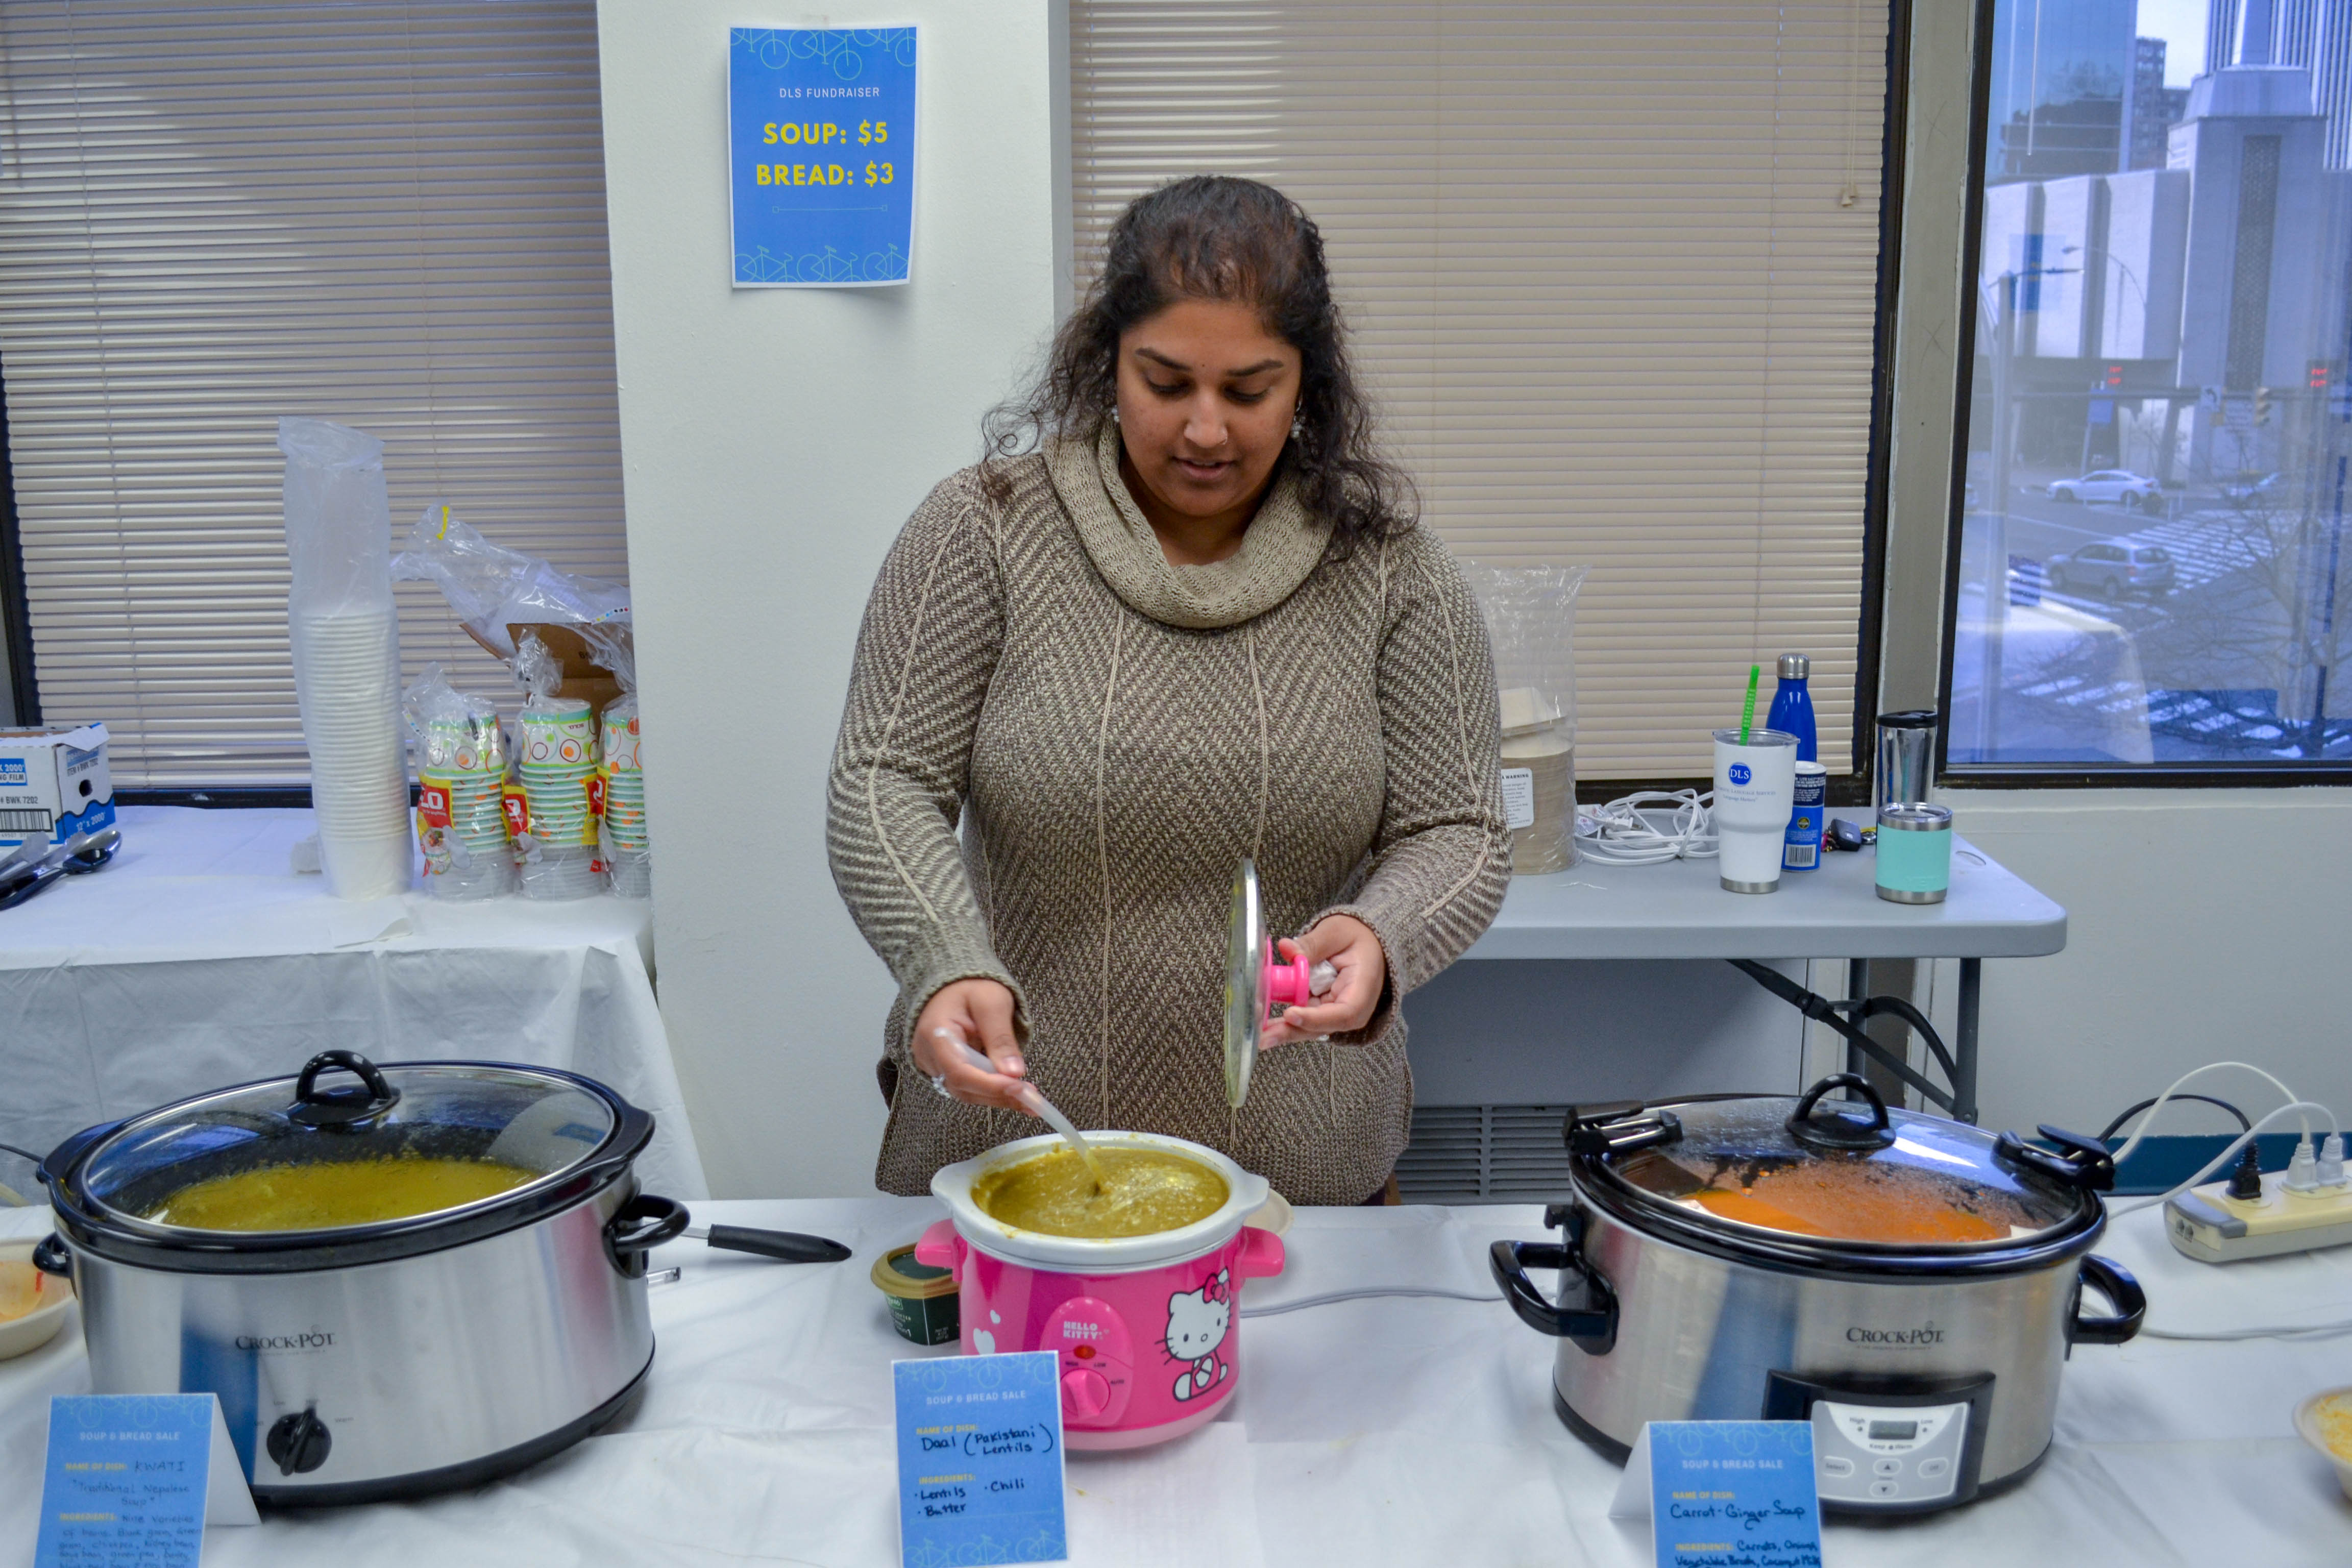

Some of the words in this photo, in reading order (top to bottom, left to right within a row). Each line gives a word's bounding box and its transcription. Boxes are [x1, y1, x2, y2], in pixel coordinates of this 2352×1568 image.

[779, 88, 801, 98] DLS
[807, 87, 879, 97] FUNDRAISER
[763, 123, 846, 144] SOUP:
[858, 119, 888, 146] $5
[756, 164, 853, 185] BREAD:
[865, 160, 893, 187] $3
[1730, 769, 1749, 779] DLS
[1064, 1321, 1098, 1331] HELLO
[1064, 1330, 1098, 1340] KITTY
[926, 1396, 953, 1405] SOUP
[966, 1392, 998, 1403] BREAD
[1002, 1390, 1026, 1400] SALE
[916, 1427, 940, 1435] NAME
[943, 1425, 954, 1433] OF
[80, 1432, 106, 1441] SOUP
[120, 1432, 152, 1440] BREAD
[155, 1431, 180, 1440] SALE
[922, 1436, 955, 1451] Daal
[66, 1462, 88, 1471] NAME
[91, 1462, 103, 1471] OF
[1682, 1460, 1708, 1469] SOUP
[1723, 1460, 1755, 1469] BREAD
[1758, 1460, 1783, 1469] SALE
[921, 1486, 966, 1500] Lentils
[991, 1478, 1024, 1491] Chili
[924, 1504, 966, 1516] Butter
[1773, 1500, 1805, 1520] Soup
